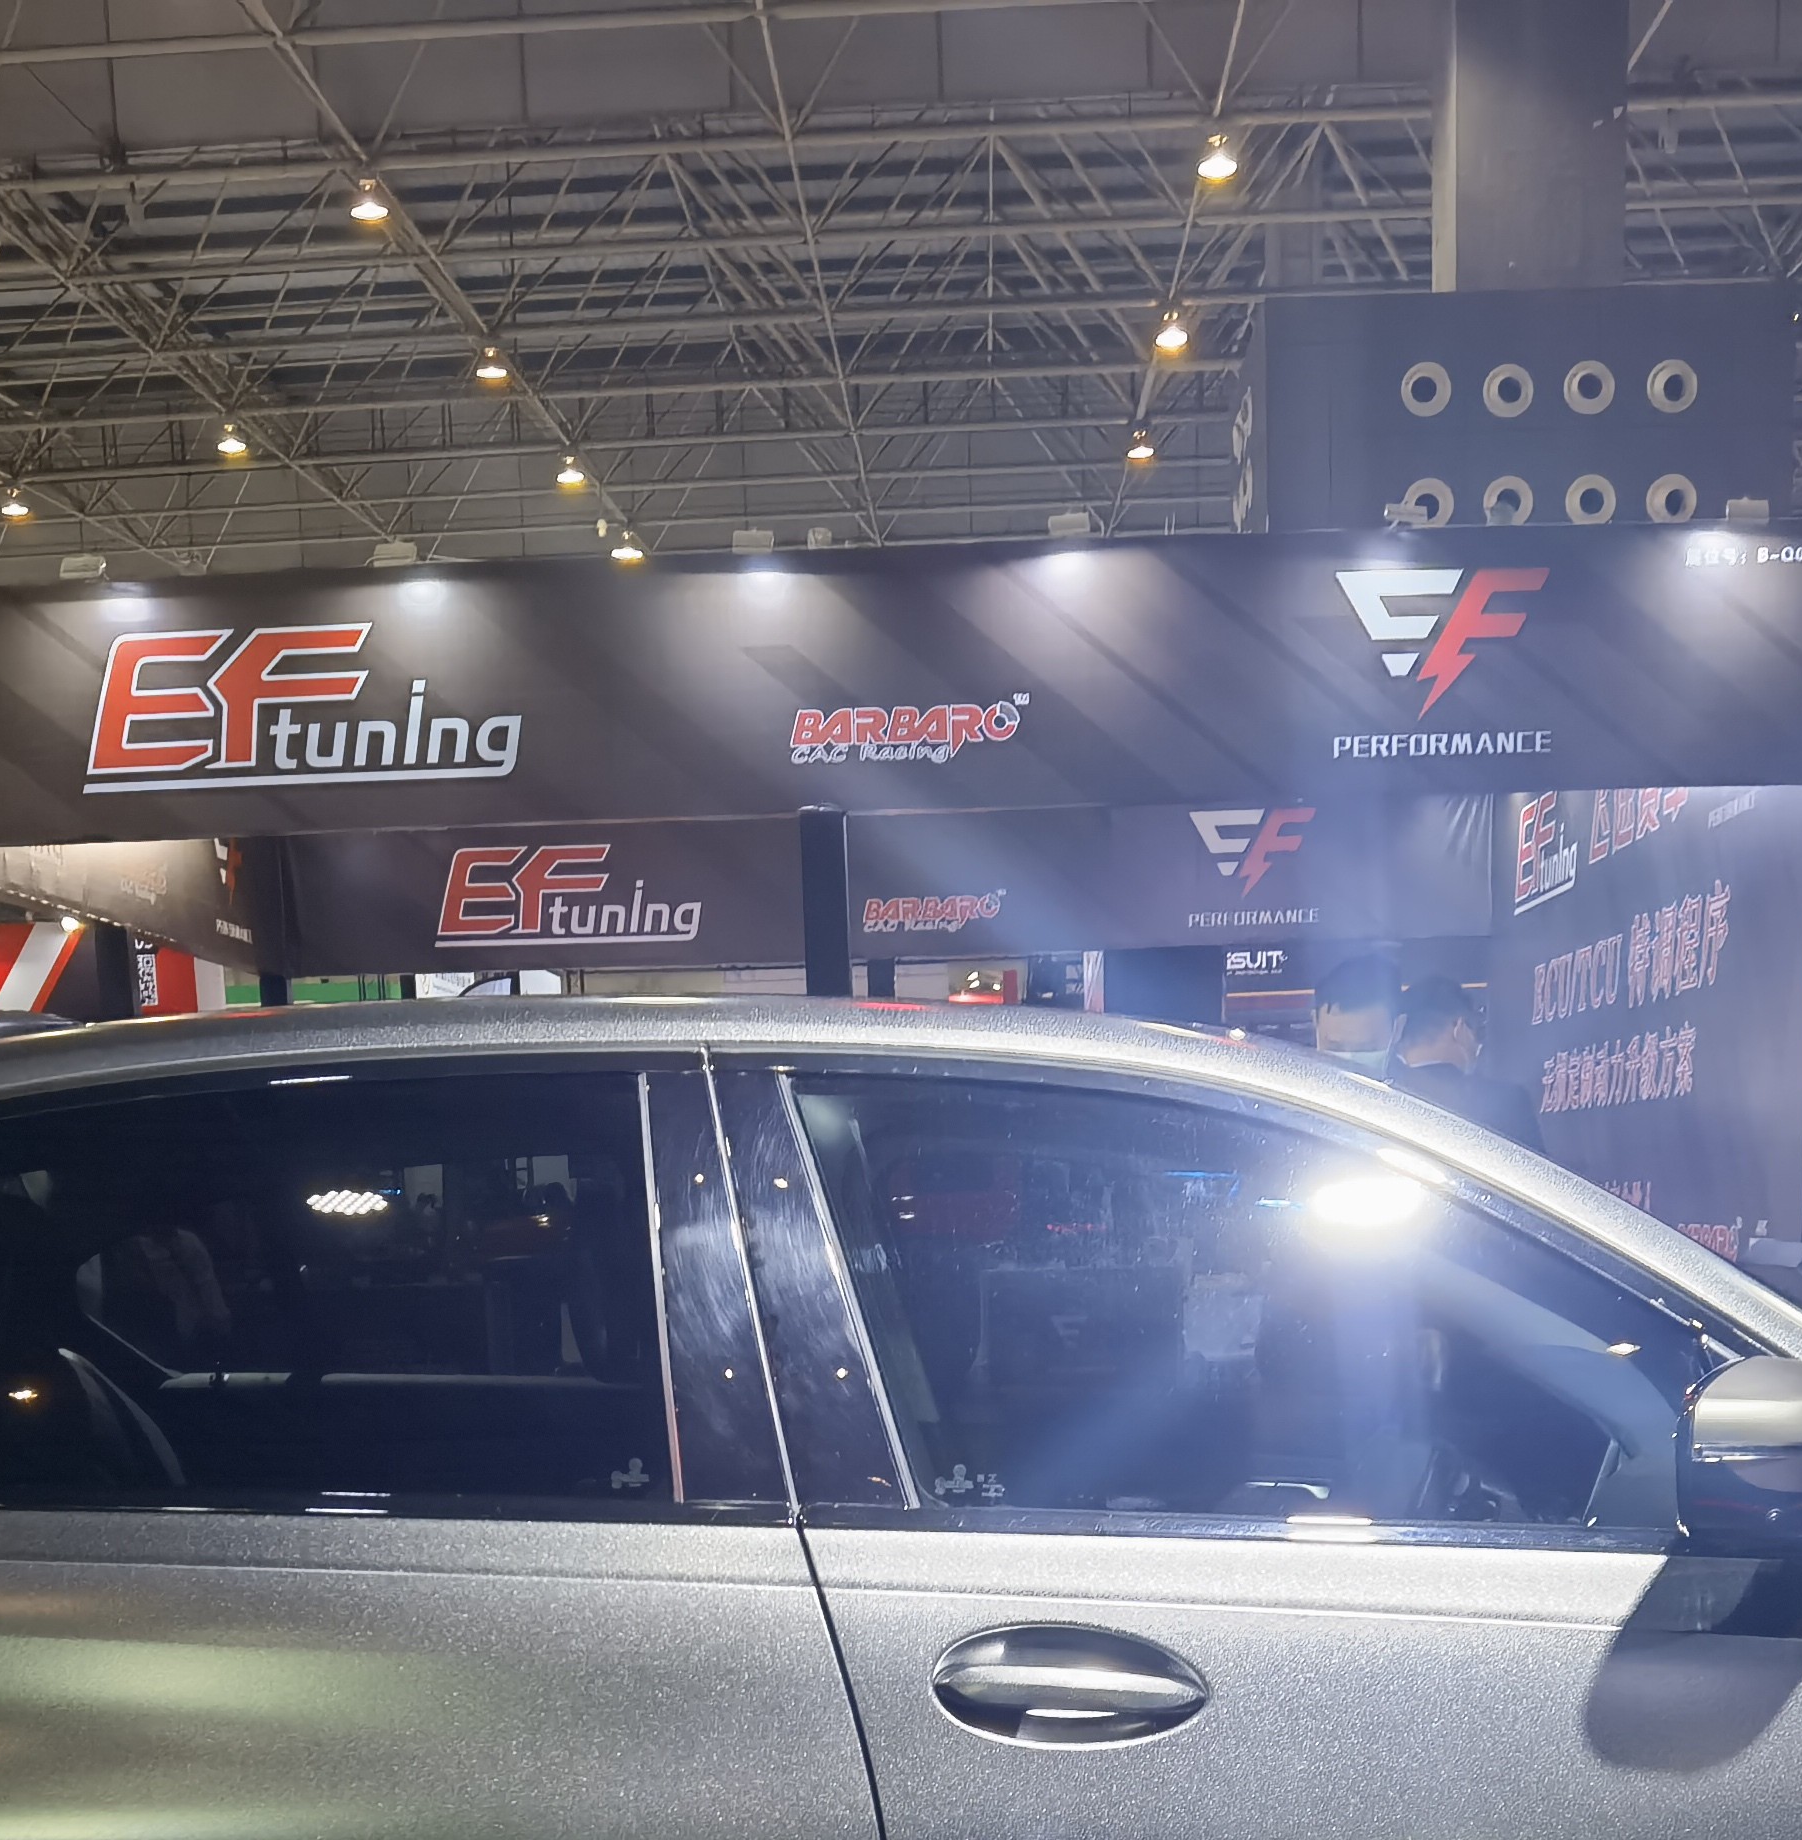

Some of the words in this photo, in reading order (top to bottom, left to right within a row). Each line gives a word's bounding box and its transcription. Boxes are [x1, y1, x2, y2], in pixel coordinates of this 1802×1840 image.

[269, 679, 523, 777] tuning
[790, 700, 1021, 757] BARBARO
[859, 742, 950, 764] Racing
[1333, 730, 1552, 759] PERFORMANCE
[549, 880, 701, 941] tuning
[863, 894, 1001, 926] BARBARO
[1188, 907, 1320, 928] PERFORMANCE
